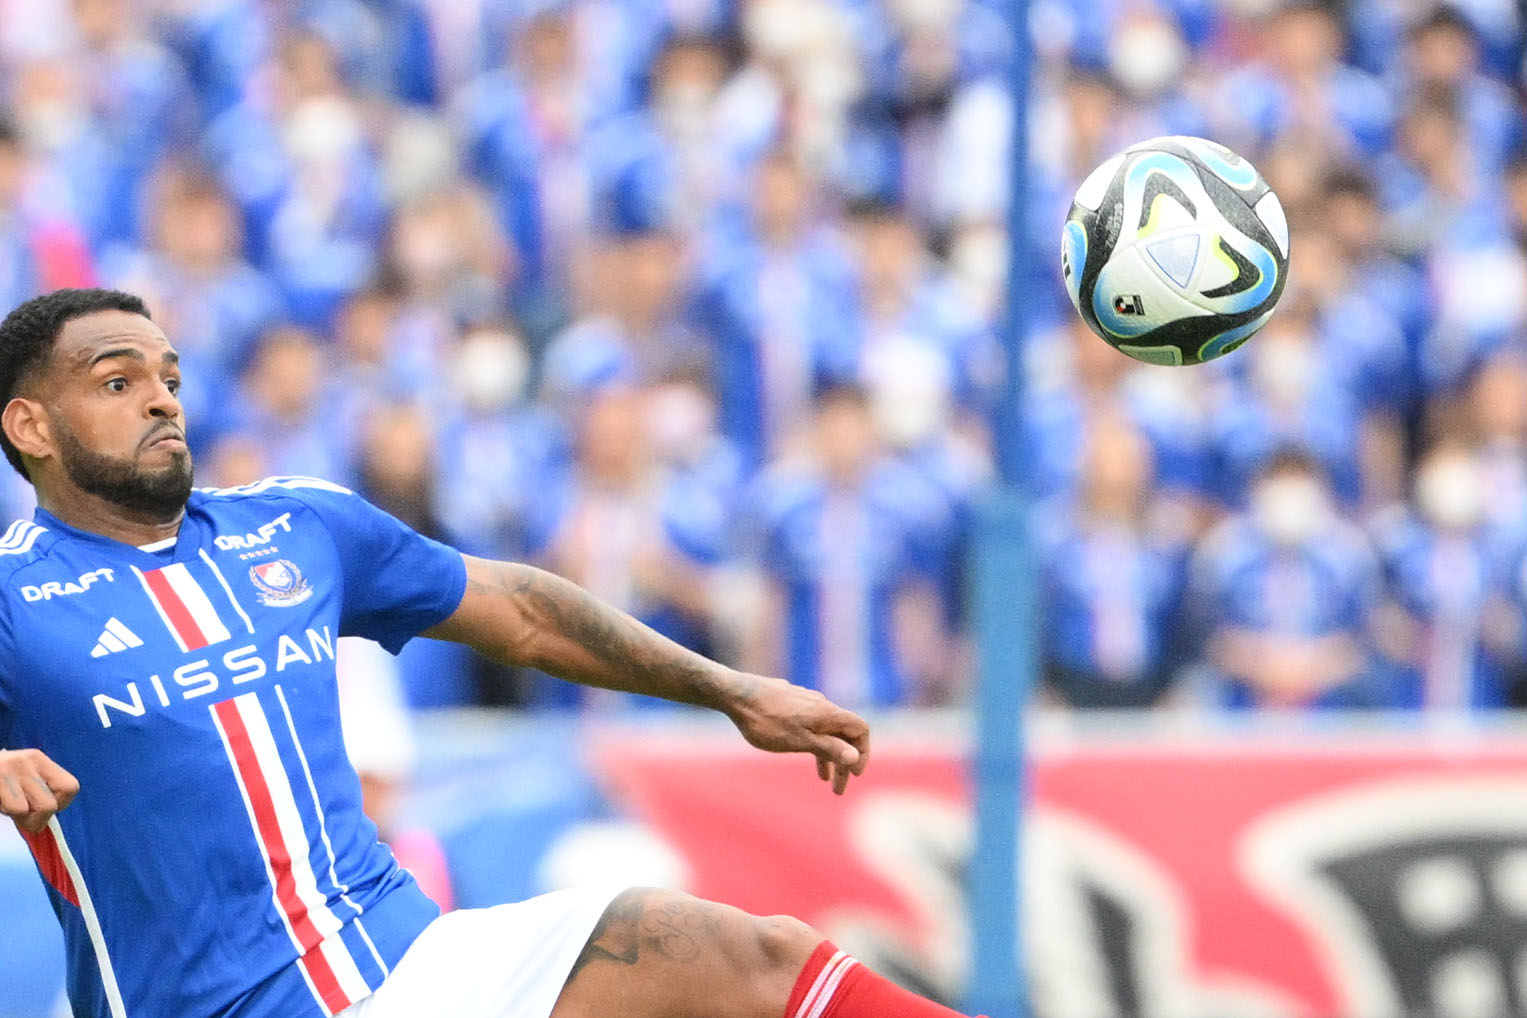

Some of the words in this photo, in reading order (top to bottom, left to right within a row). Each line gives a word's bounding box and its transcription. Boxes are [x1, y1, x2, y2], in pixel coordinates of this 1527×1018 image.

[214, 512, 292, 550] DRAFT
[21, 568, 114, 602] DRAFT
[92, 625, 335, 728] NISSAN
